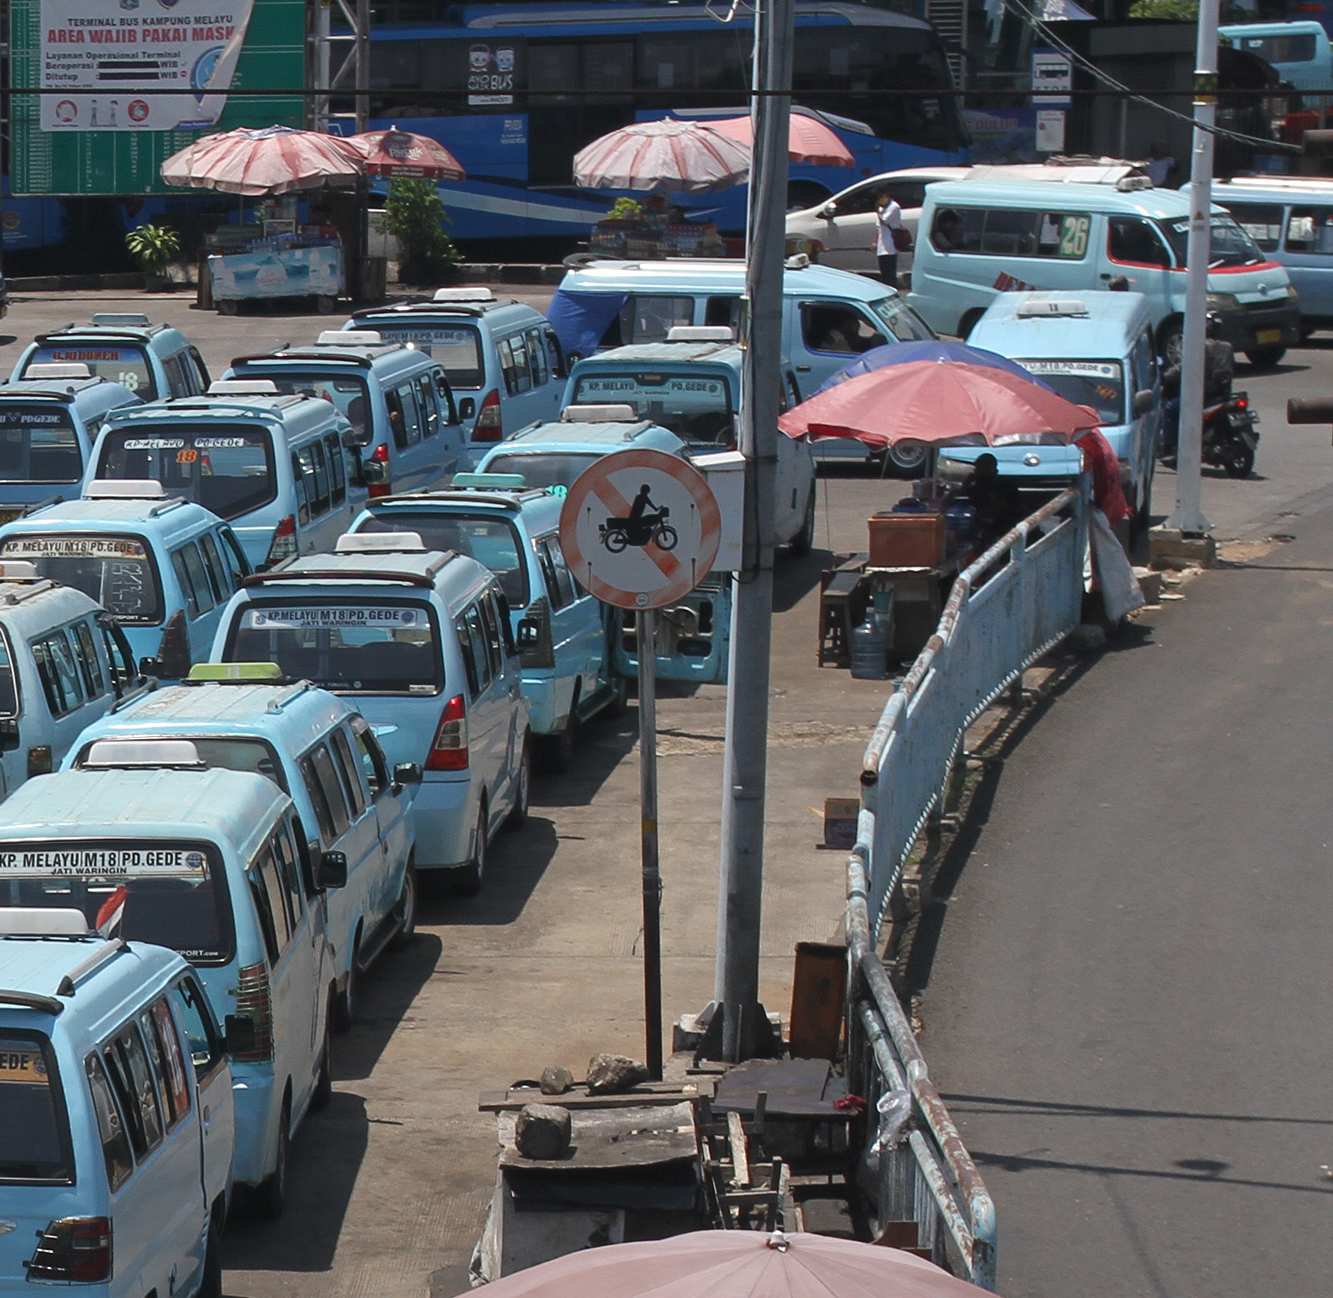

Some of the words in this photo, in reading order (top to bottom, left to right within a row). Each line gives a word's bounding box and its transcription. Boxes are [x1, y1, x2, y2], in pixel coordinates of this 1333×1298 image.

[68, 18, 116, 27] TERMINAL
[119, 17, 139, 26] BUS
[142, 16, 191, 26] KAMPUNG
[194, 15, 233, 24] MELAYU
[47, 29, 85, 43] AREA
[89, 28, 137, 43] WAJIB
[142, 27, 187, 42] PAKAI
[46, 51, 83, 60] Layanan
[86, 51, 138, 61] Operasional
[142, 50, 180, 59] Terminal
[46, 61, 94, 71] Beroperasi
[160, 60, 178, 69] WIB
[46, 72, 78, 81] Ditutup
[160, 71, 178, 80] WIB
[491, 74, 513, 90] BUS
[1063, 215, 1088, 257] 26
[420, 331, 455, 341] PD.GEDE
[588, 382, 600, 391] KP.
[602, 381, 635, 391] MELAYU
[671, 382, 708, 392] PD.GEDE
[176, 450, 198, 463] 18
[22, 541, 61, 551] MELAYU
[64, 541, 86, 551] M18
[267, 610, 317, 621] KP.MELAYU
[320, 610, 346, 621] M18
[349, 610, 400, 621] PD.GEDE
[22, 852, 81, 868] MELAYU
[84, 851, 117, 867] M18
[121, 851, 183, 867] PD.GEDE
[51, 867, 73, 875] JATI
[76, 866, 128, 875] WARINGIN
